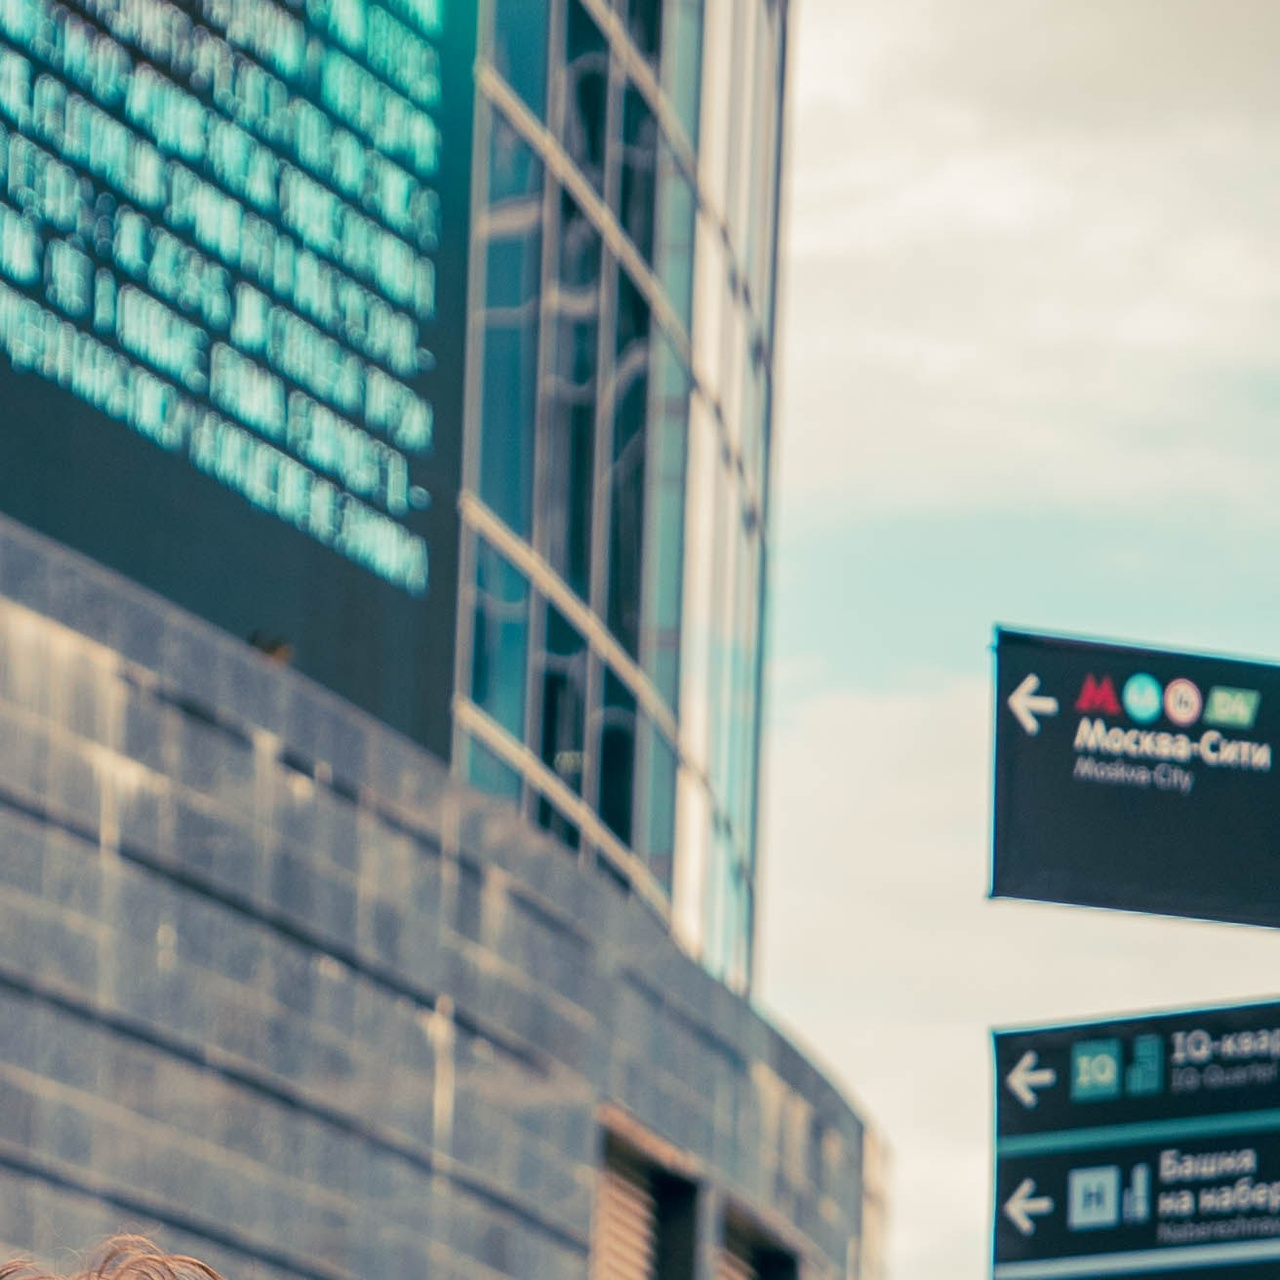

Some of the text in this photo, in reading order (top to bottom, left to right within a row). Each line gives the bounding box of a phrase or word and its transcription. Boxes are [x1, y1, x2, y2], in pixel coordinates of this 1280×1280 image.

[1073, 717, 1271, 770] Москва-Сити
[1160, 1148, 1256, 1183] Башня
[1159, 1190, 1195, 1216] на
